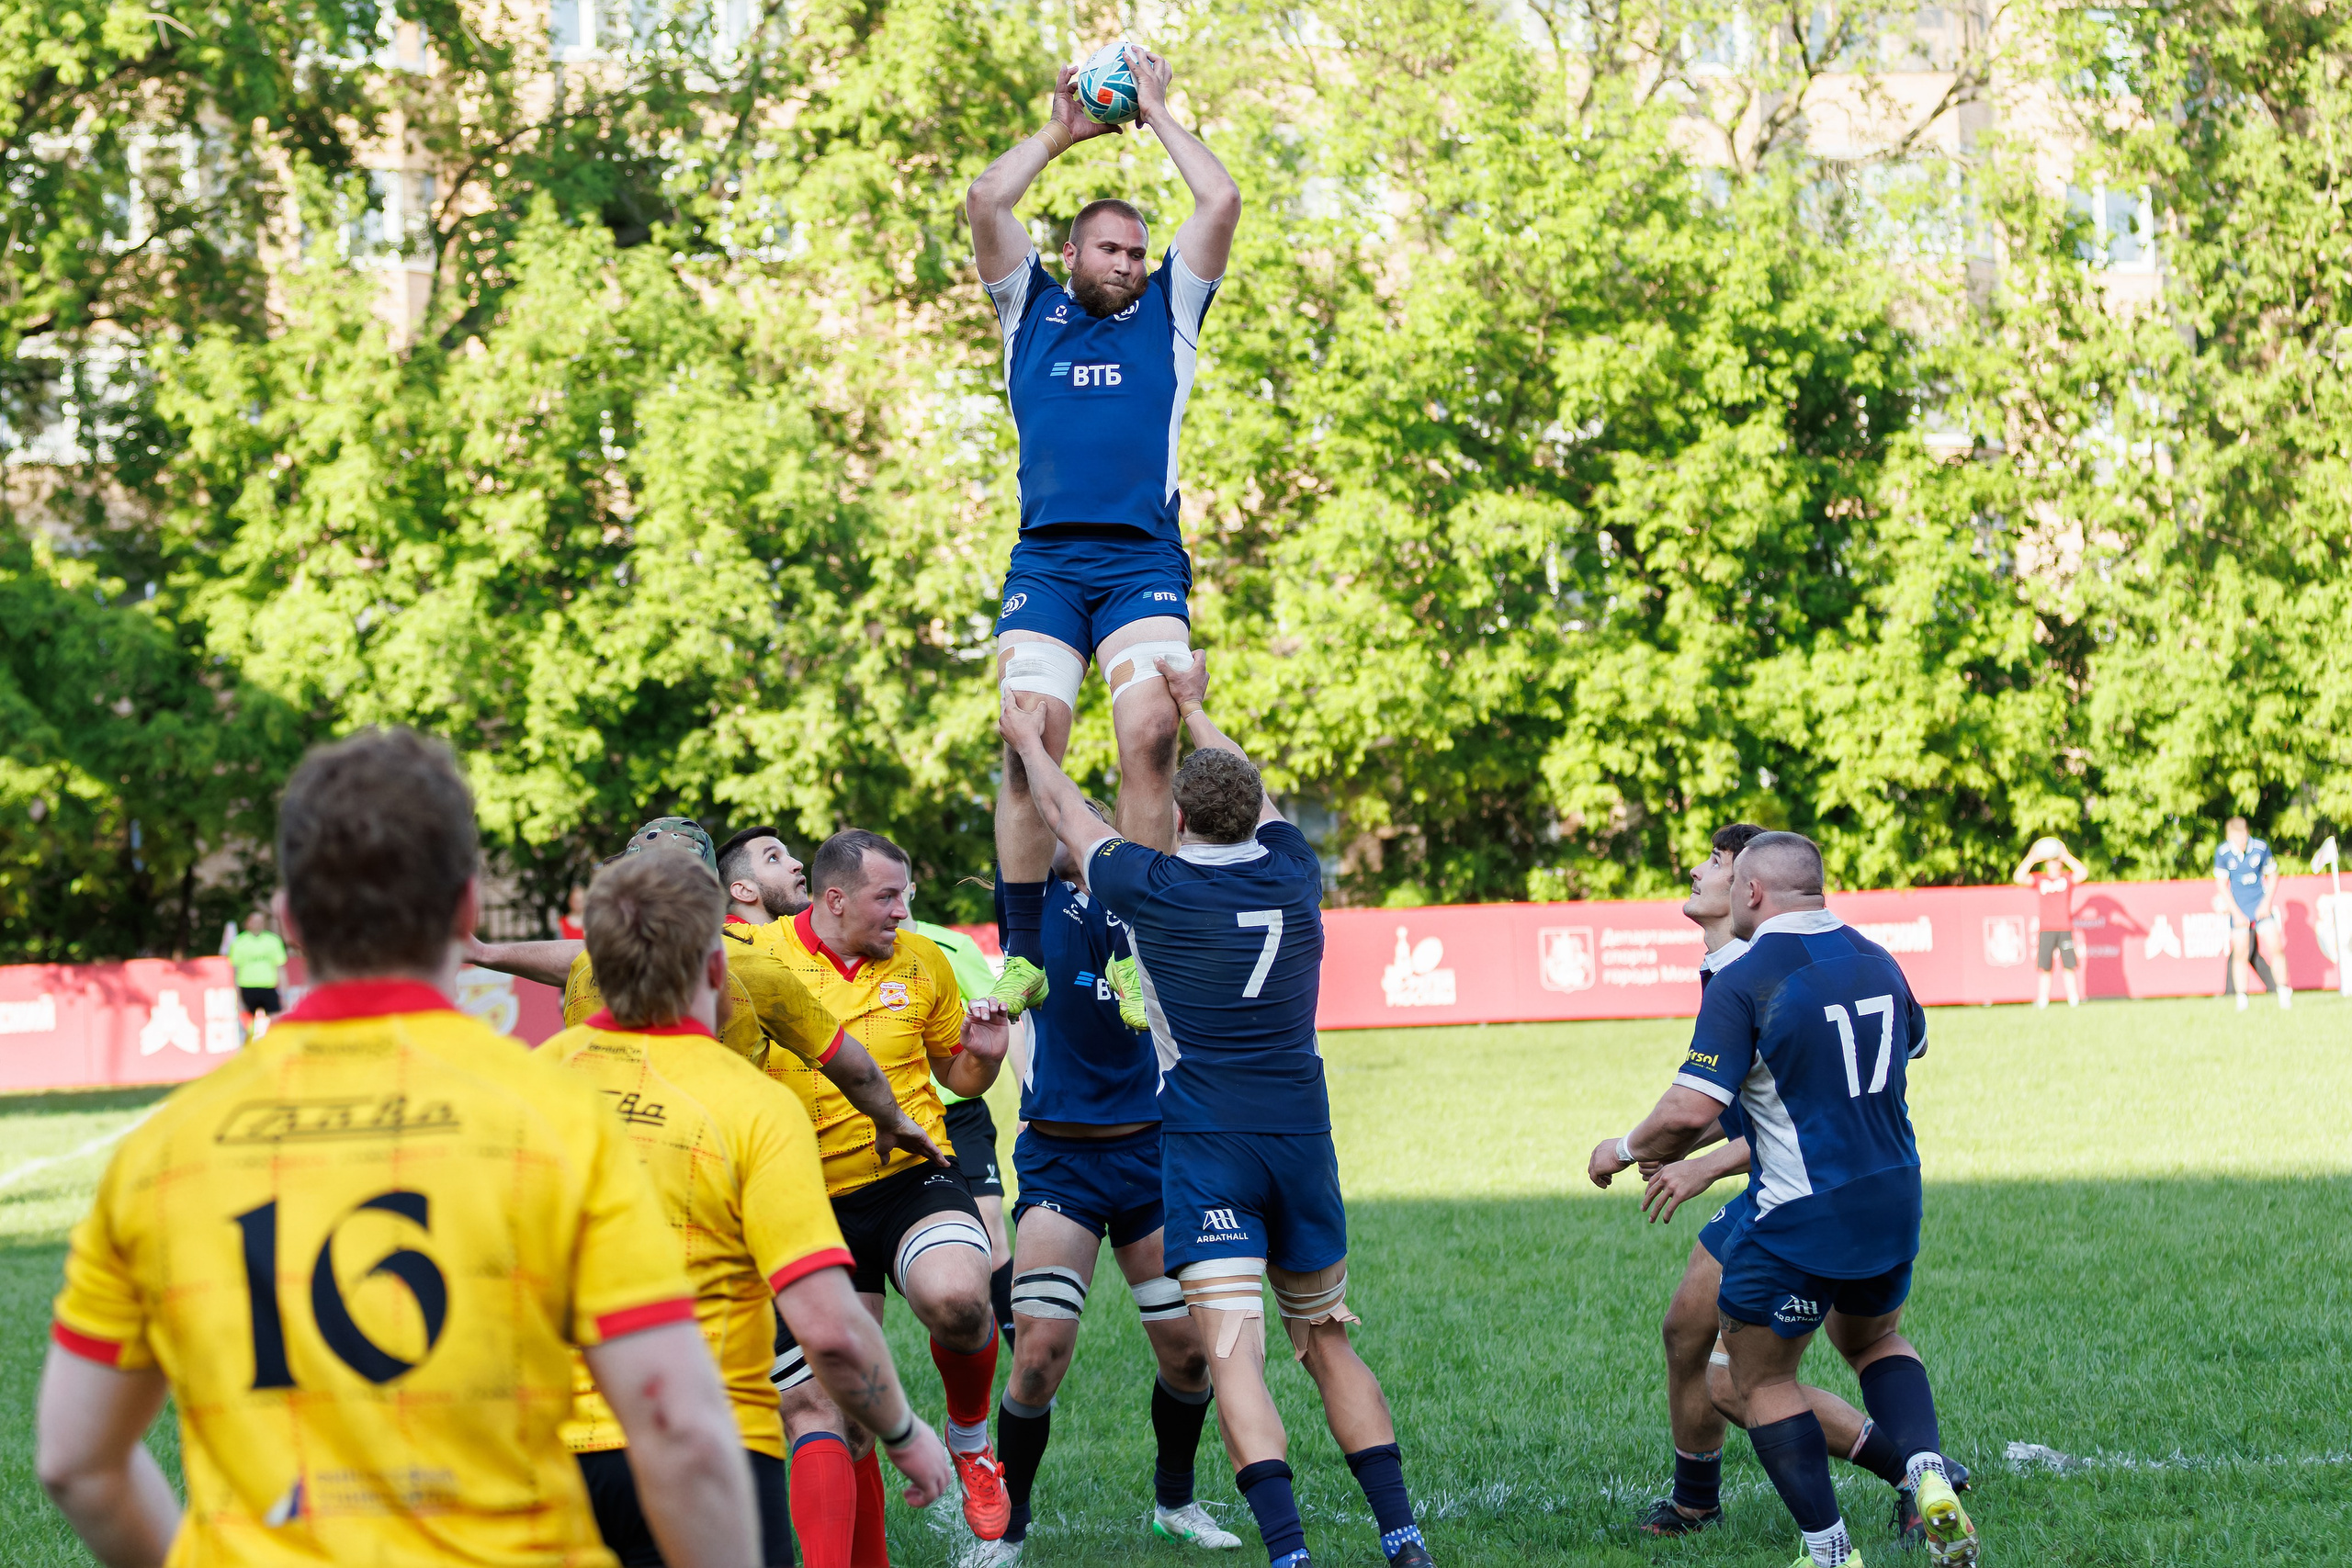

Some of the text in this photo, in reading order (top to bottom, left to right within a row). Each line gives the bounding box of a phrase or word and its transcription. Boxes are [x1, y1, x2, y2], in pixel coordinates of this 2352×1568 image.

[1073, 364, 1122, 387] ВТБ
[1153, 592, 1178, 602] ВТБ
[1236, 909, 1283, 998] 7
[1824, 994, 1894, 1099] 17
[1196, 1232, 1250, 1244] ARBATHALL
[232, 1190, 448, 1390] 16
